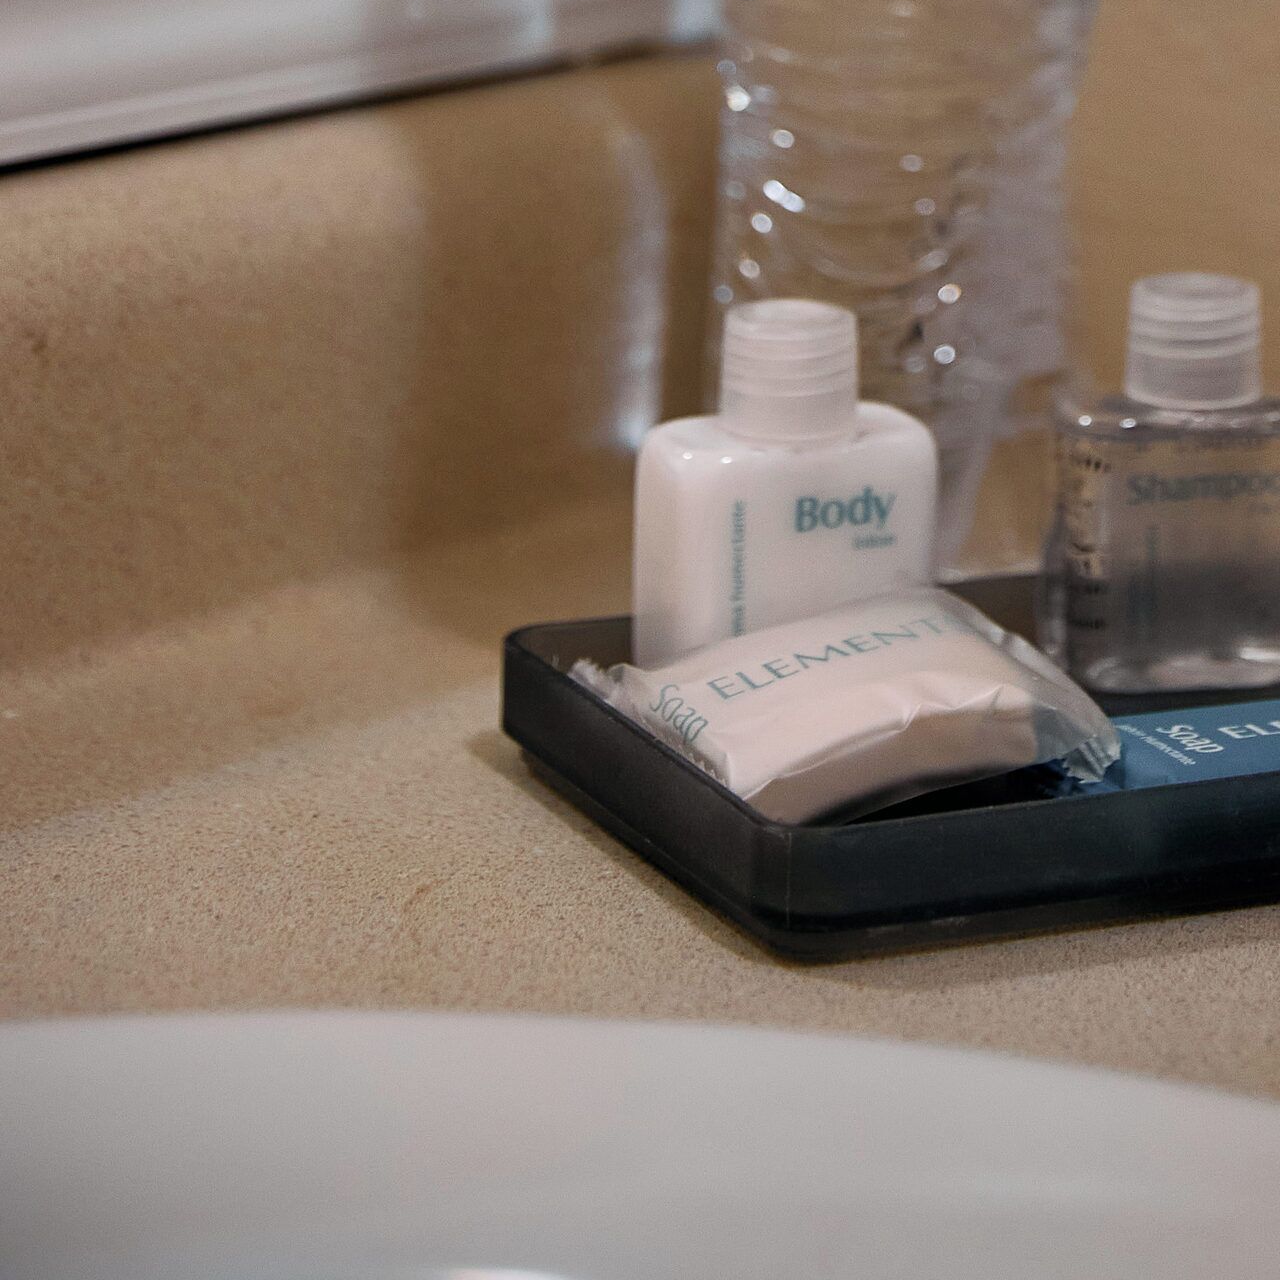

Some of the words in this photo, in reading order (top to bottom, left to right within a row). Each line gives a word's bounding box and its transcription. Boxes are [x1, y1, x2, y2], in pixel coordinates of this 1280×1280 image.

[795, 485, 897, 532] Body
[706, 612, 966, 700] ELEMENT
[649, 684, 708, 746] Soap
[1156, 724, 1225, 753] Soap
